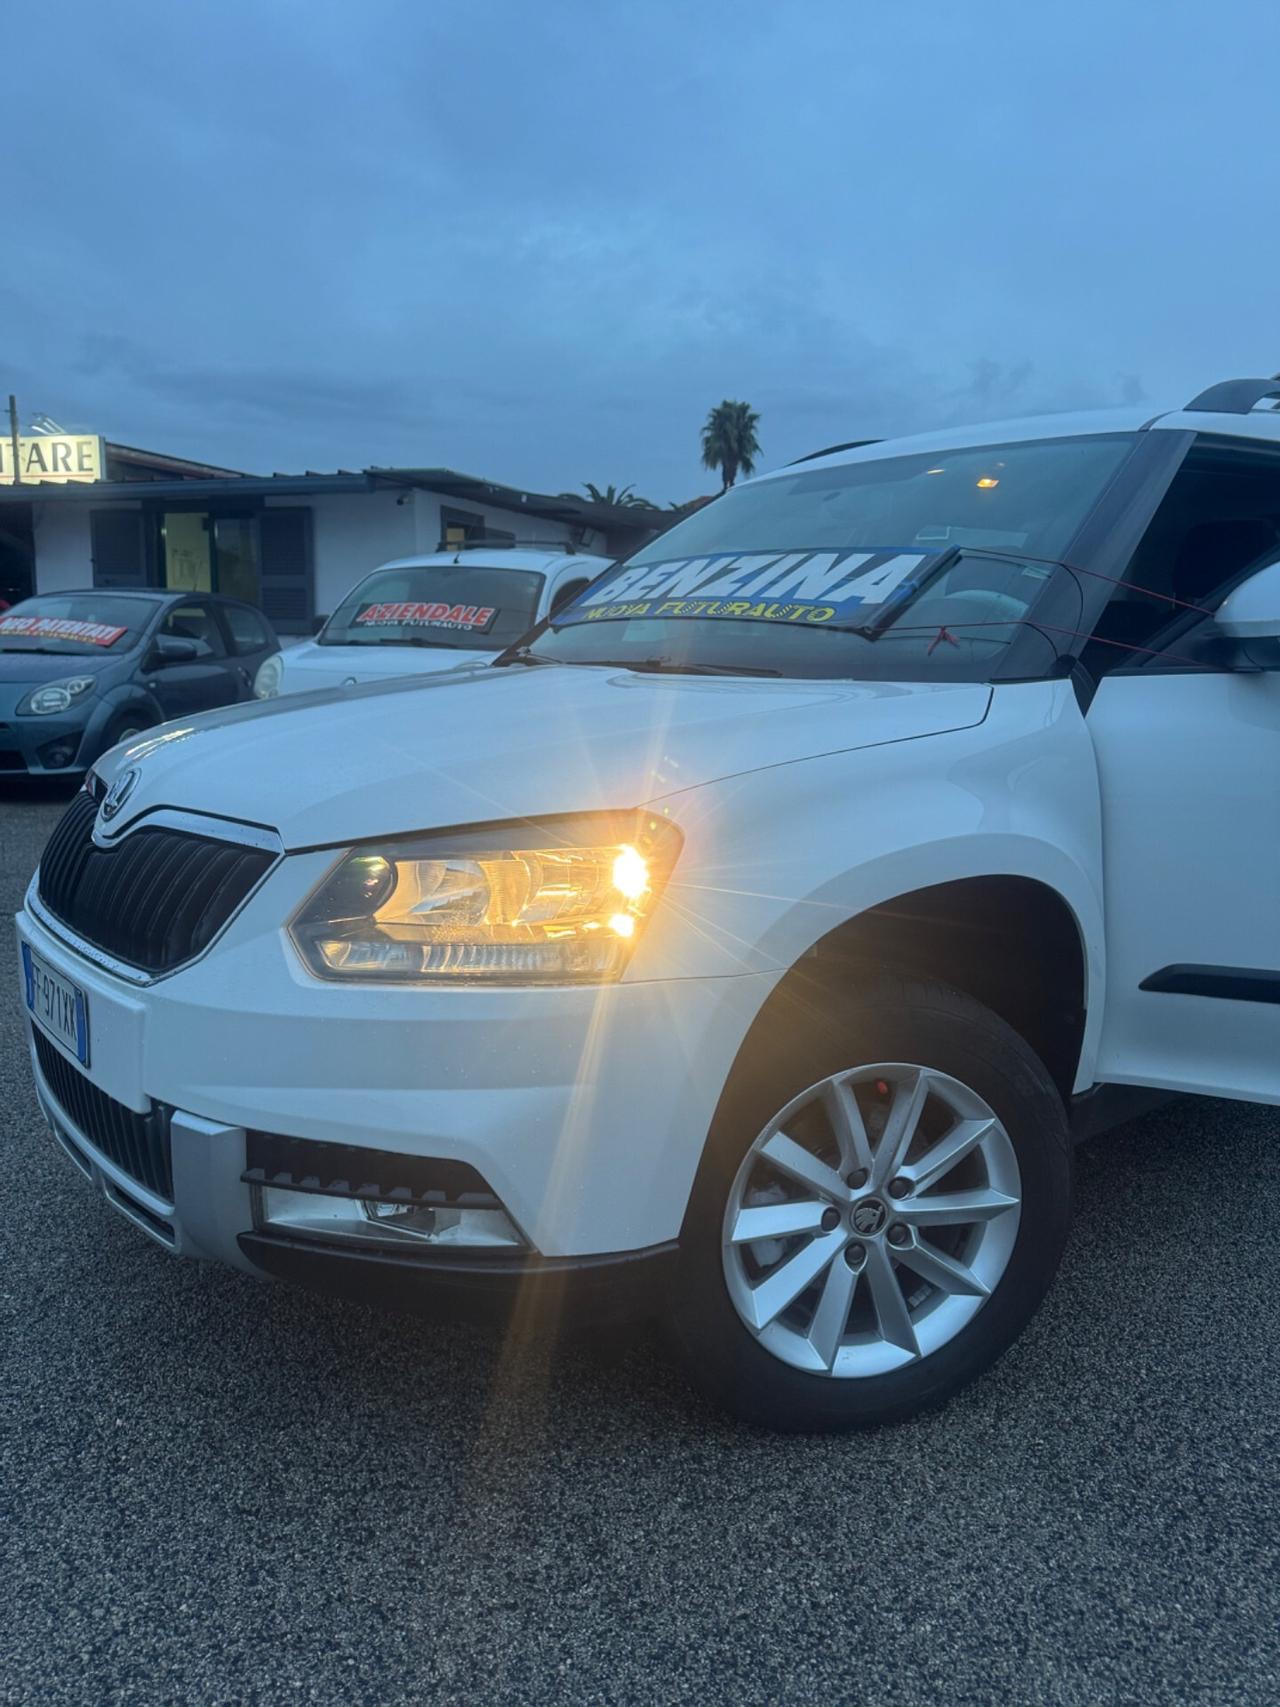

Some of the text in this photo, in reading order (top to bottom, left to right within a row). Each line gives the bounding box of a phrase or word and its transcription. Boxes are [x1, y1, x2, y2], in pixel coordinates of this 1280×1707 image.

[580, 553, 927, 606] BENZINA
[356, 603, 496, 626] AZIENDALE
[583, 602, 836, 622] NUOVA FUTURAUTO
